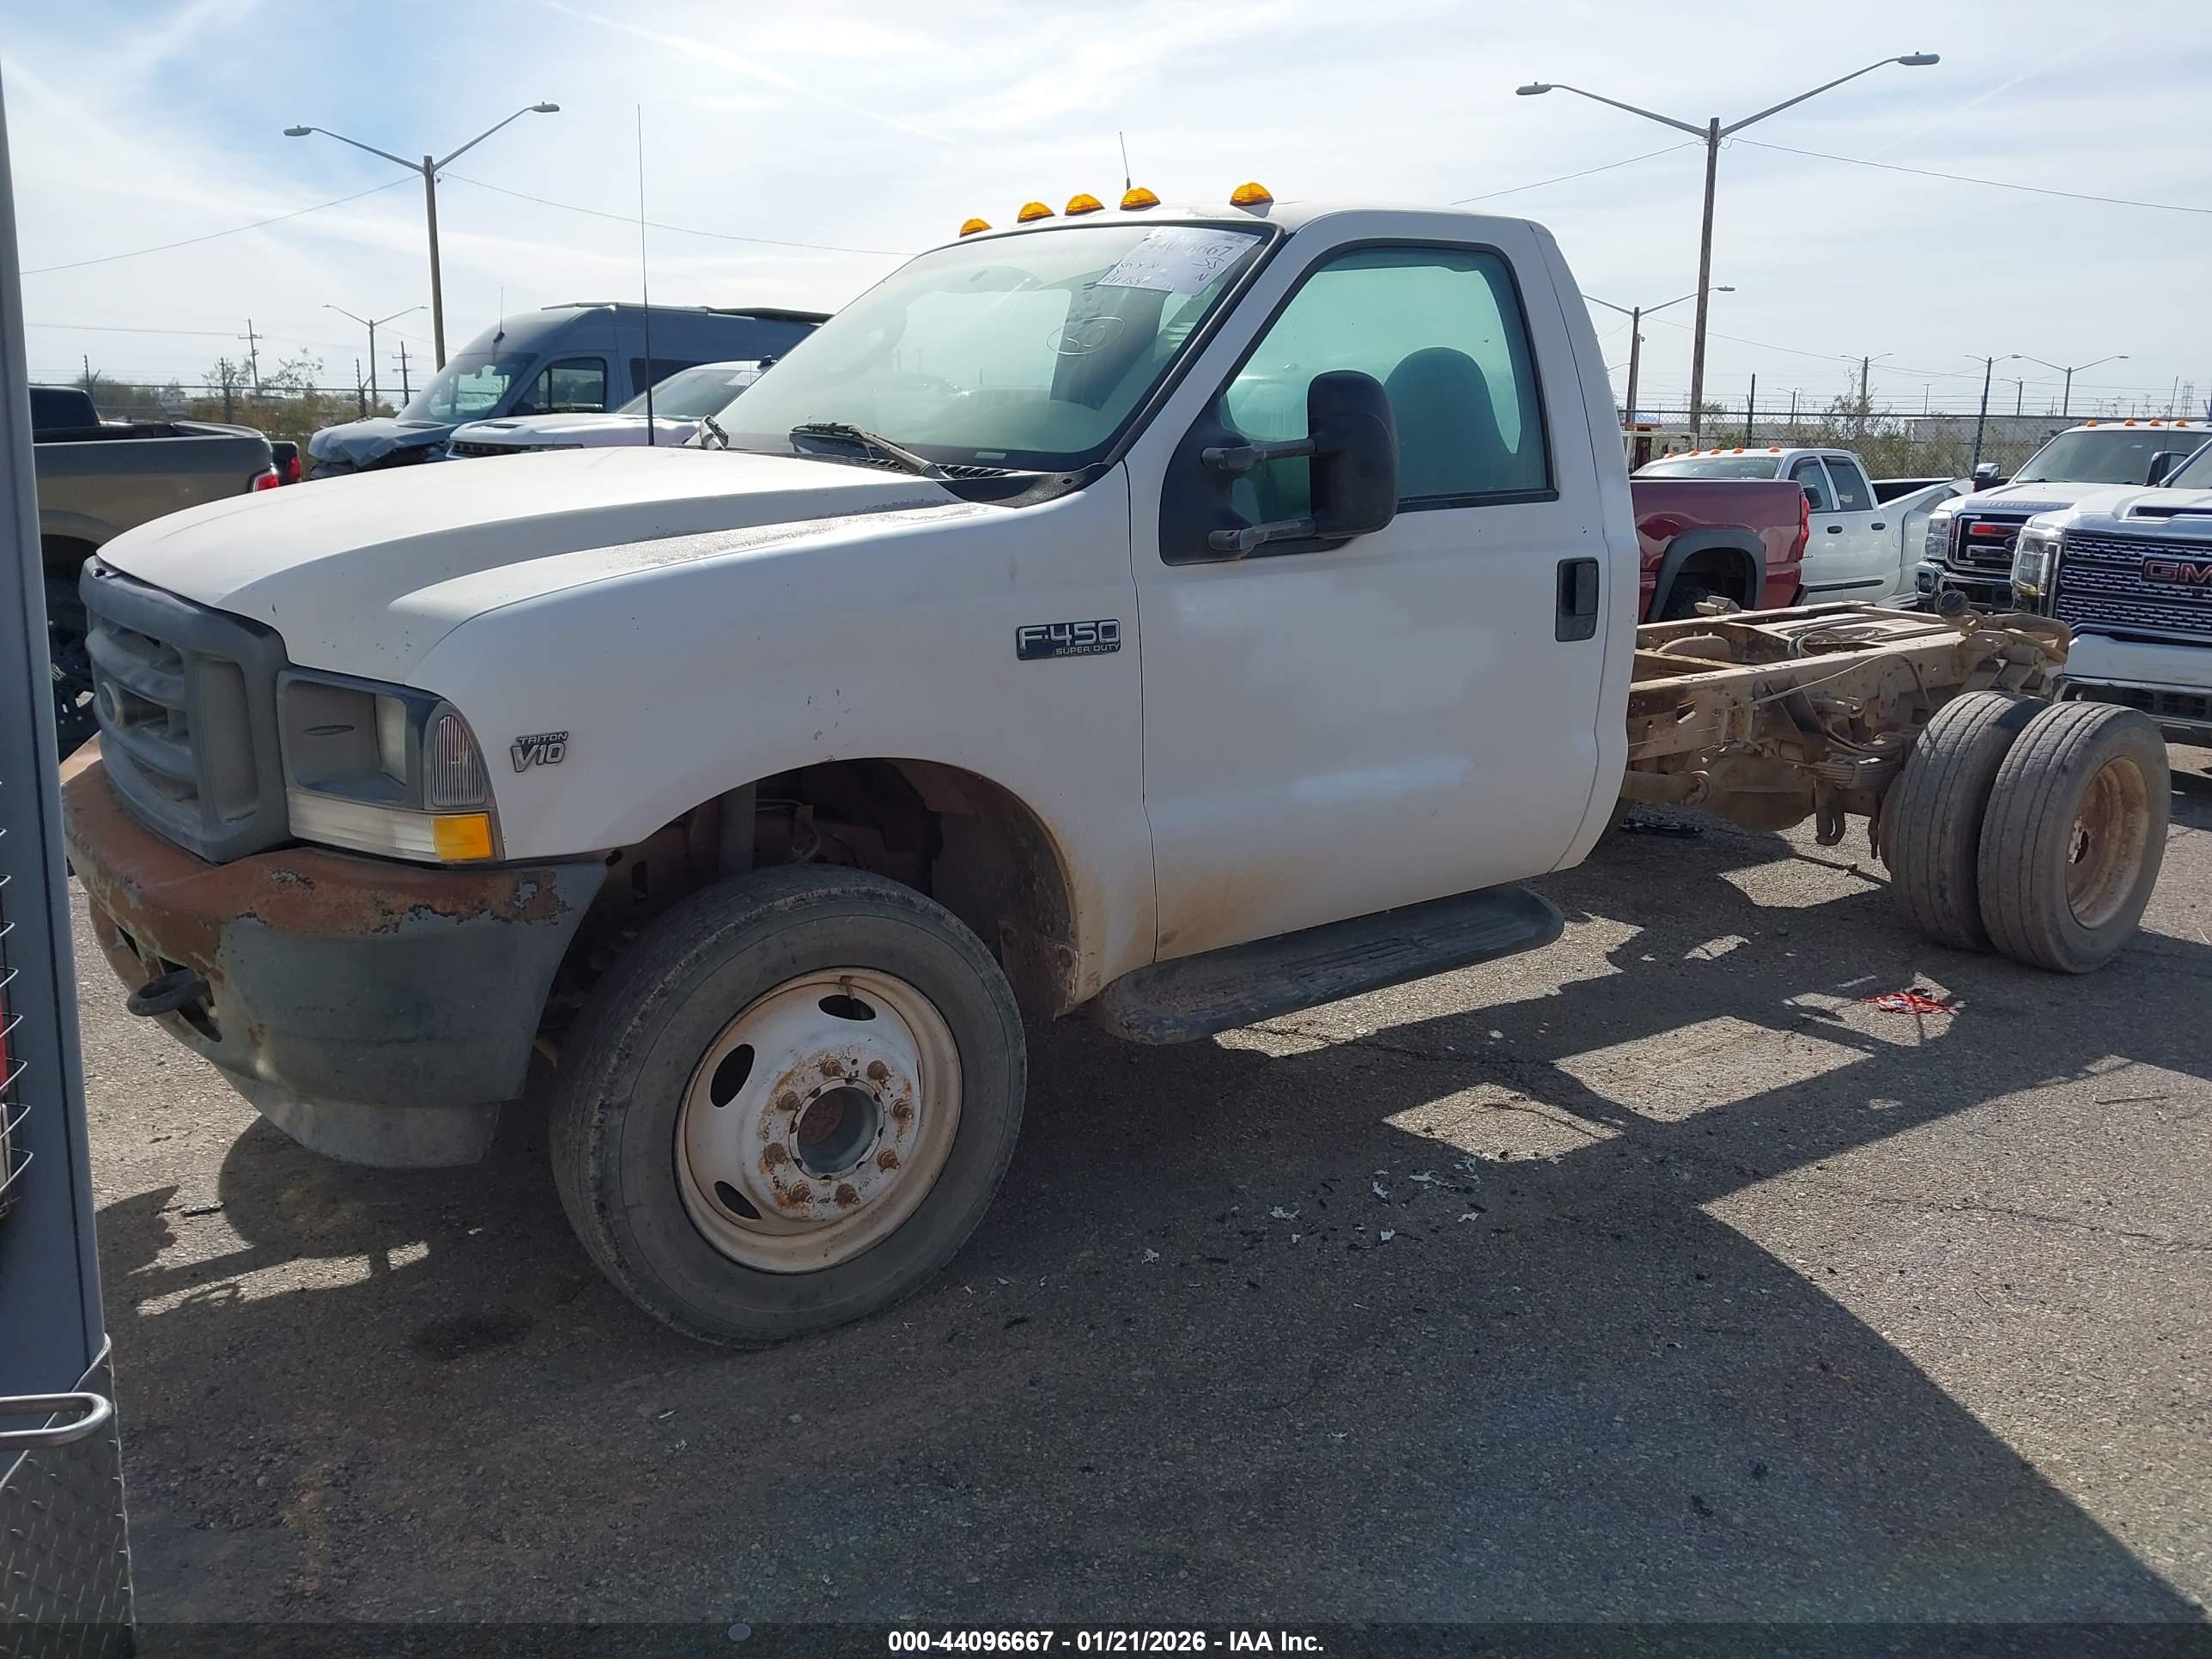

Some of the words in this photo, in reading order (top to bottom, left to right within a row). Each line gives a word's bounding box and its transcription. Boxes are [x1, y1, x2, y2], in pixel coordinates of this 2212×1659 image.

[1018, 620, 1121, 651] F-450
[1055, 646, 1091, 656] SUPER
[1092, 643, 1121, 653] DUTY
[518, 732, 568, 744] TRITON
[510, 742, 565, 773] V10
